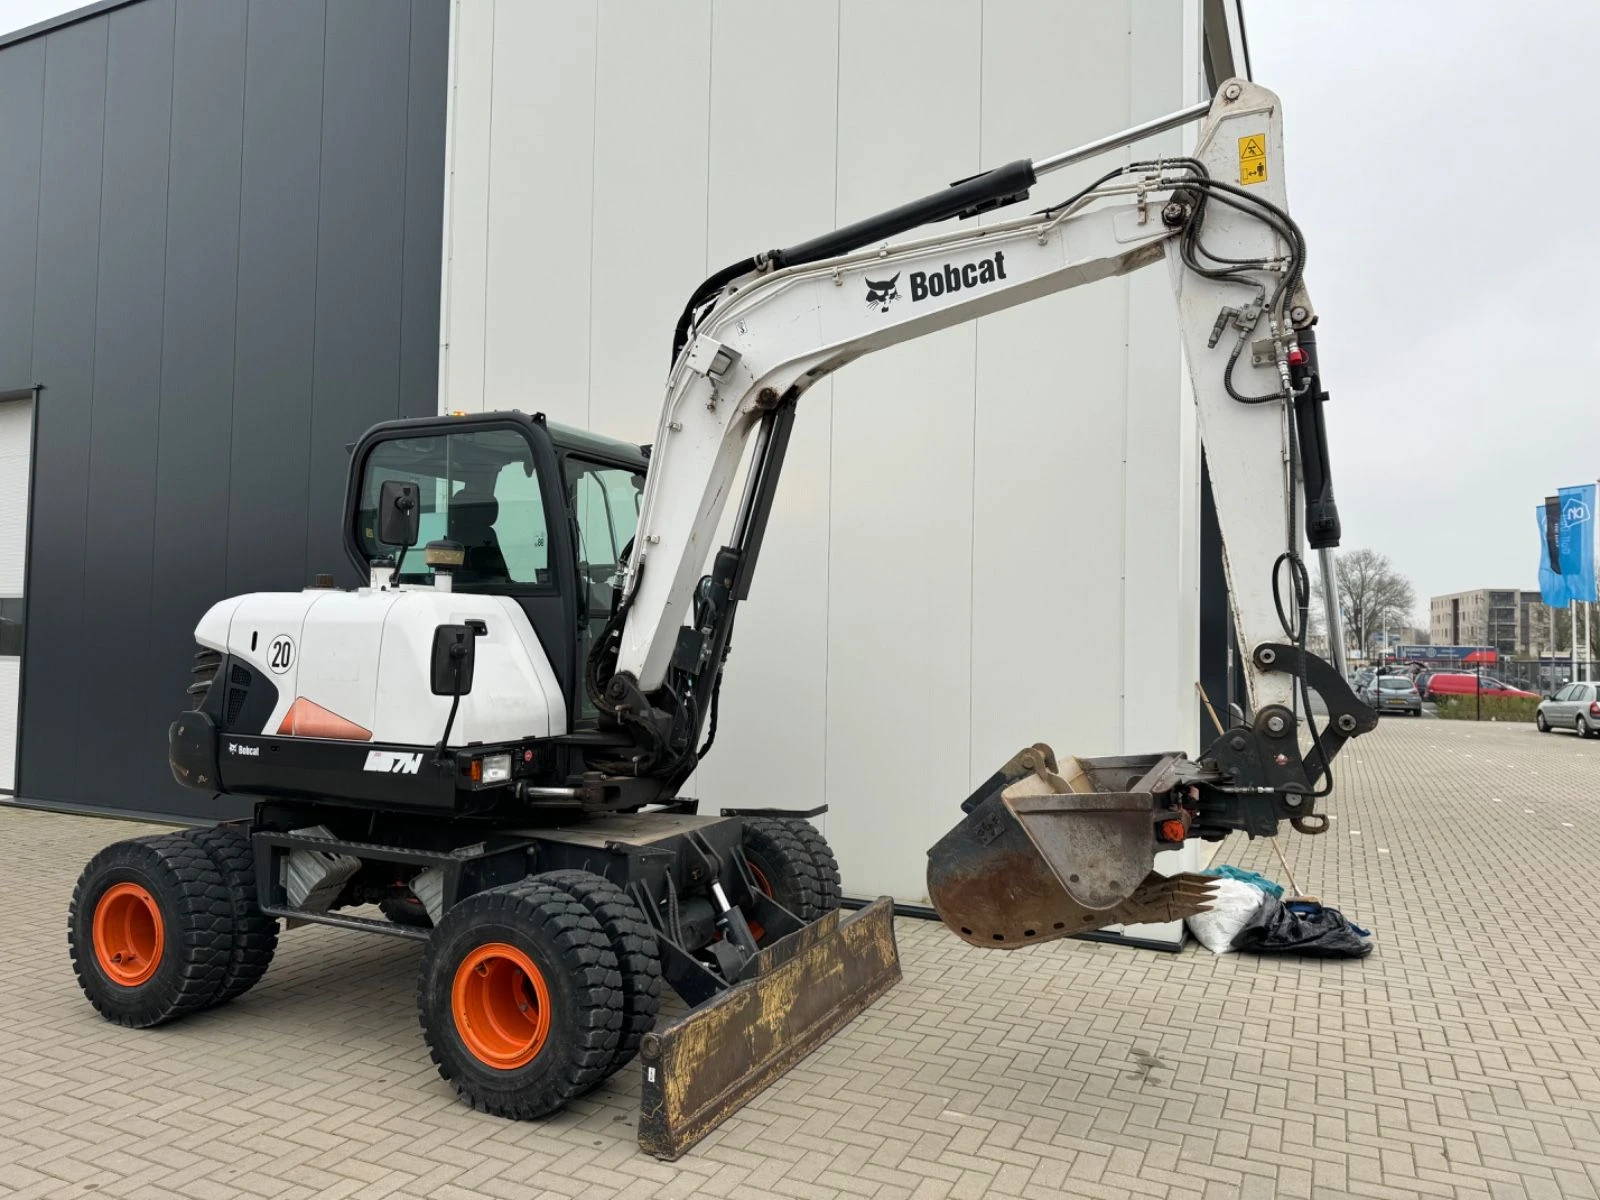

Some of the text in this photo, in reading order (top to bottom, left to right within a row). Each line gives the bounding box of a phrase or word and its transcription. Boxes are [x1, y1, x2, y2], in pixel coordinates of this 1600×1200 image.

[910, 251, 1007, 302] Bobcat
[272, 641, 291, 668] 20
[238, 745, 260, 756] Bobcat
